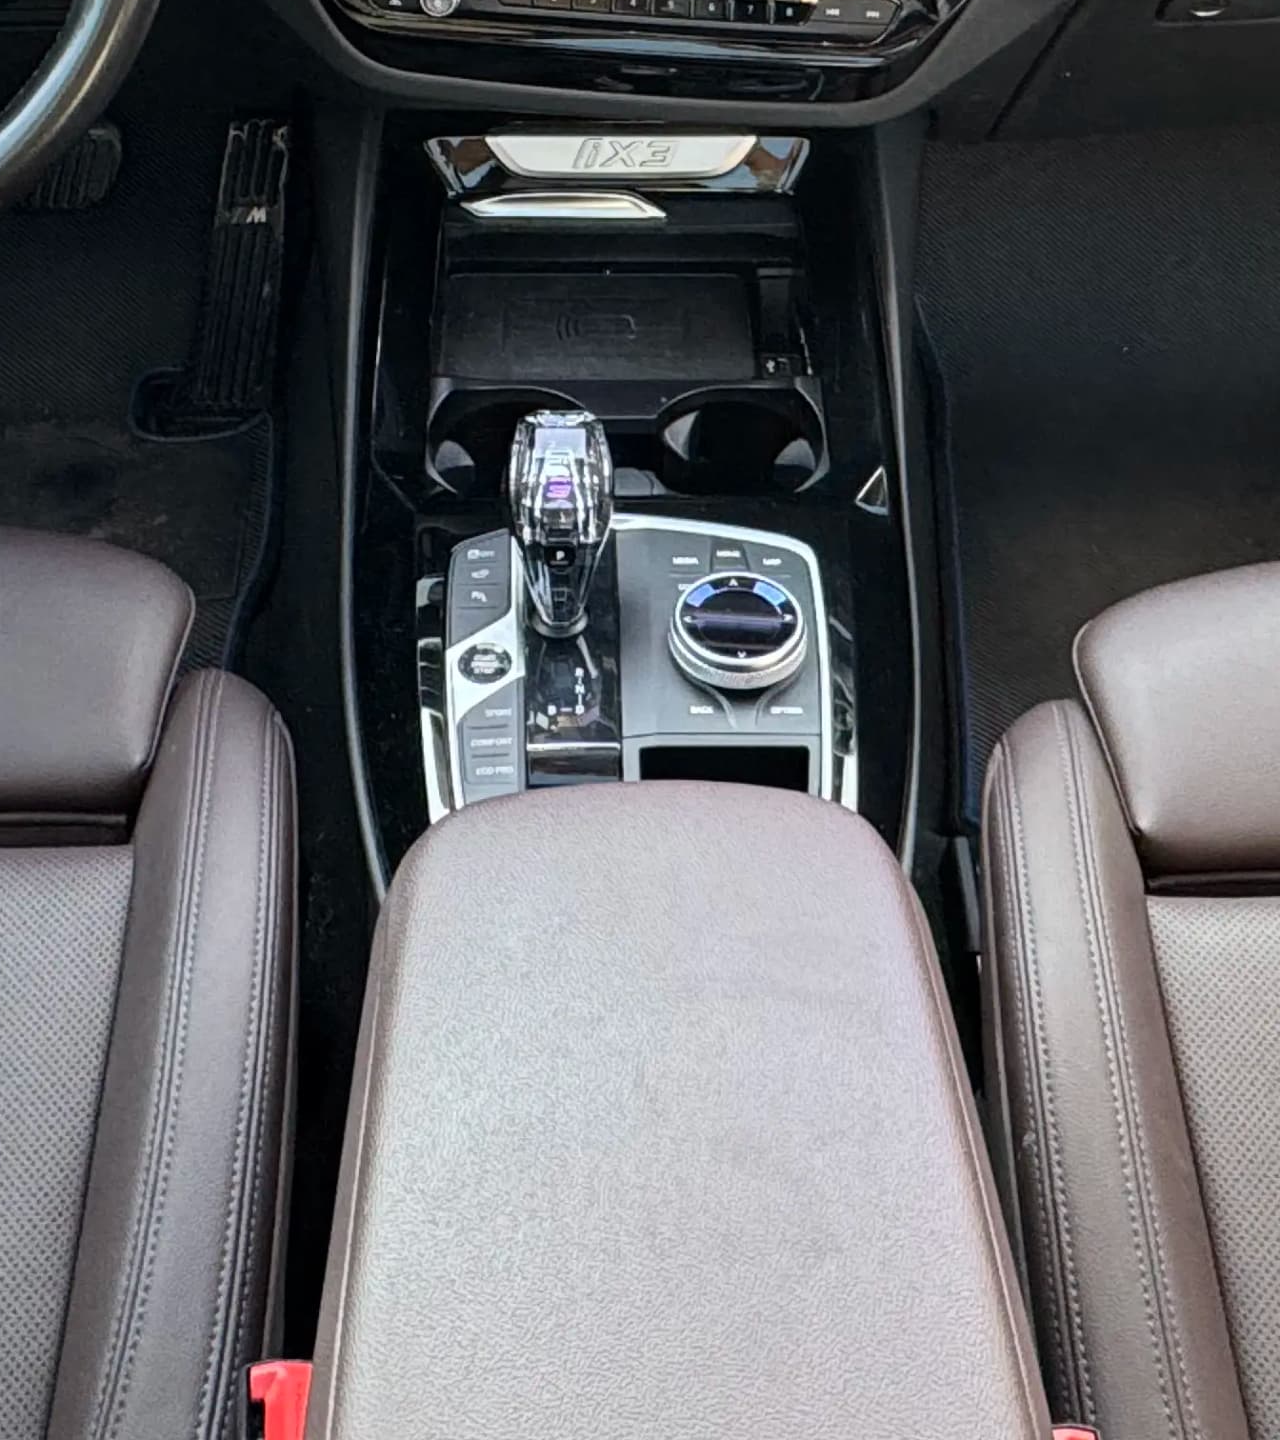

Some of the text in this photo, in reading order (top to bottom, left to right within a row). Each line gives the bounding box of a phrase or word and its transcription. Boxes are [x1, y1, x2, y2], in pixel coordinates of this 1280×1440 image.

[555, 550, 566, 561] P
[484, 708, 513, 718] SPORT
[470, 737, 513, 749] COMFORT
[475, 765, 514, 776] ECO PRO
